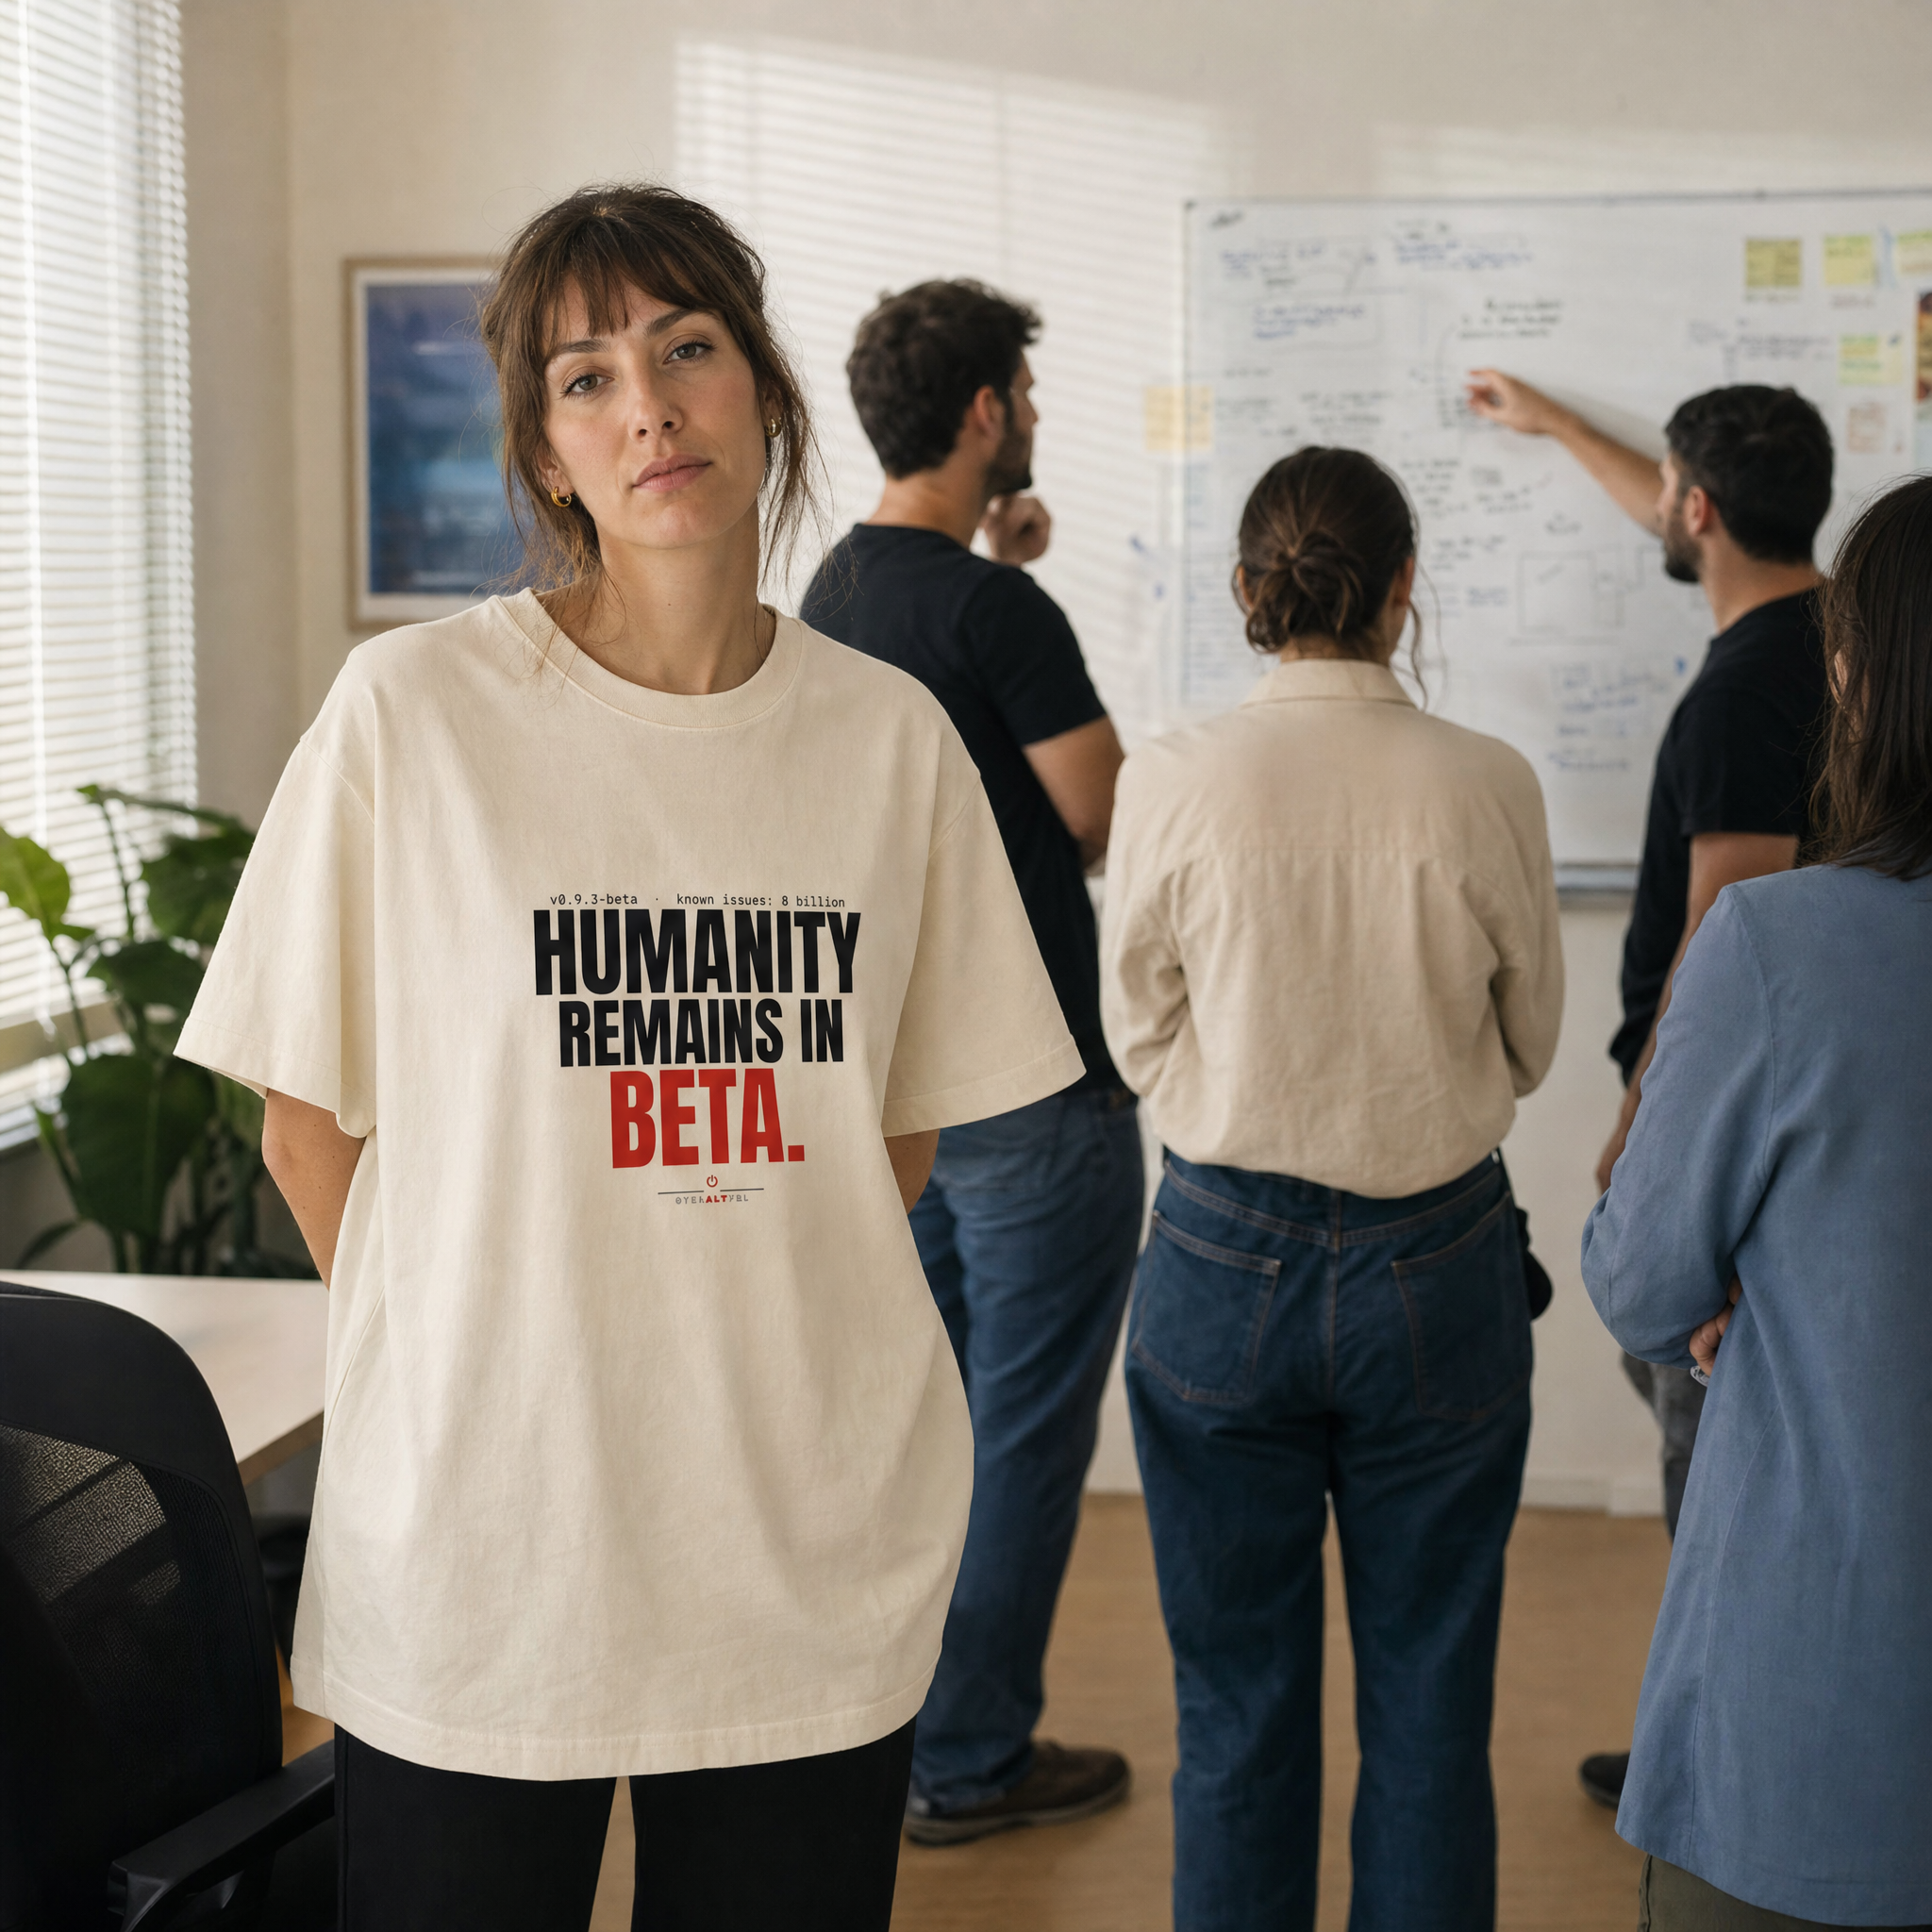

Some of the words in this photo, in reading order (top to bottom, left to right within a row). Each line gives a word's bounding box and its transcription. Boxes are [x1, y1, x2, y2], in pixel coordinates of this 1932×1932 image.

[550, 893, 638, 907] v0.9.3-beta
[676, 892, 715, 906] known
[723, 893, 772, 908] issues:
[781, 894, 789, 907] 8
[796, 895, 845, 908] billion
[533, 908, 861, 996] HUMANITY
[558, 998, 784, 1067] REMAINS
[800, 998, 844, 1063] IN
[609, 1068, 806, 1169] BETA.
